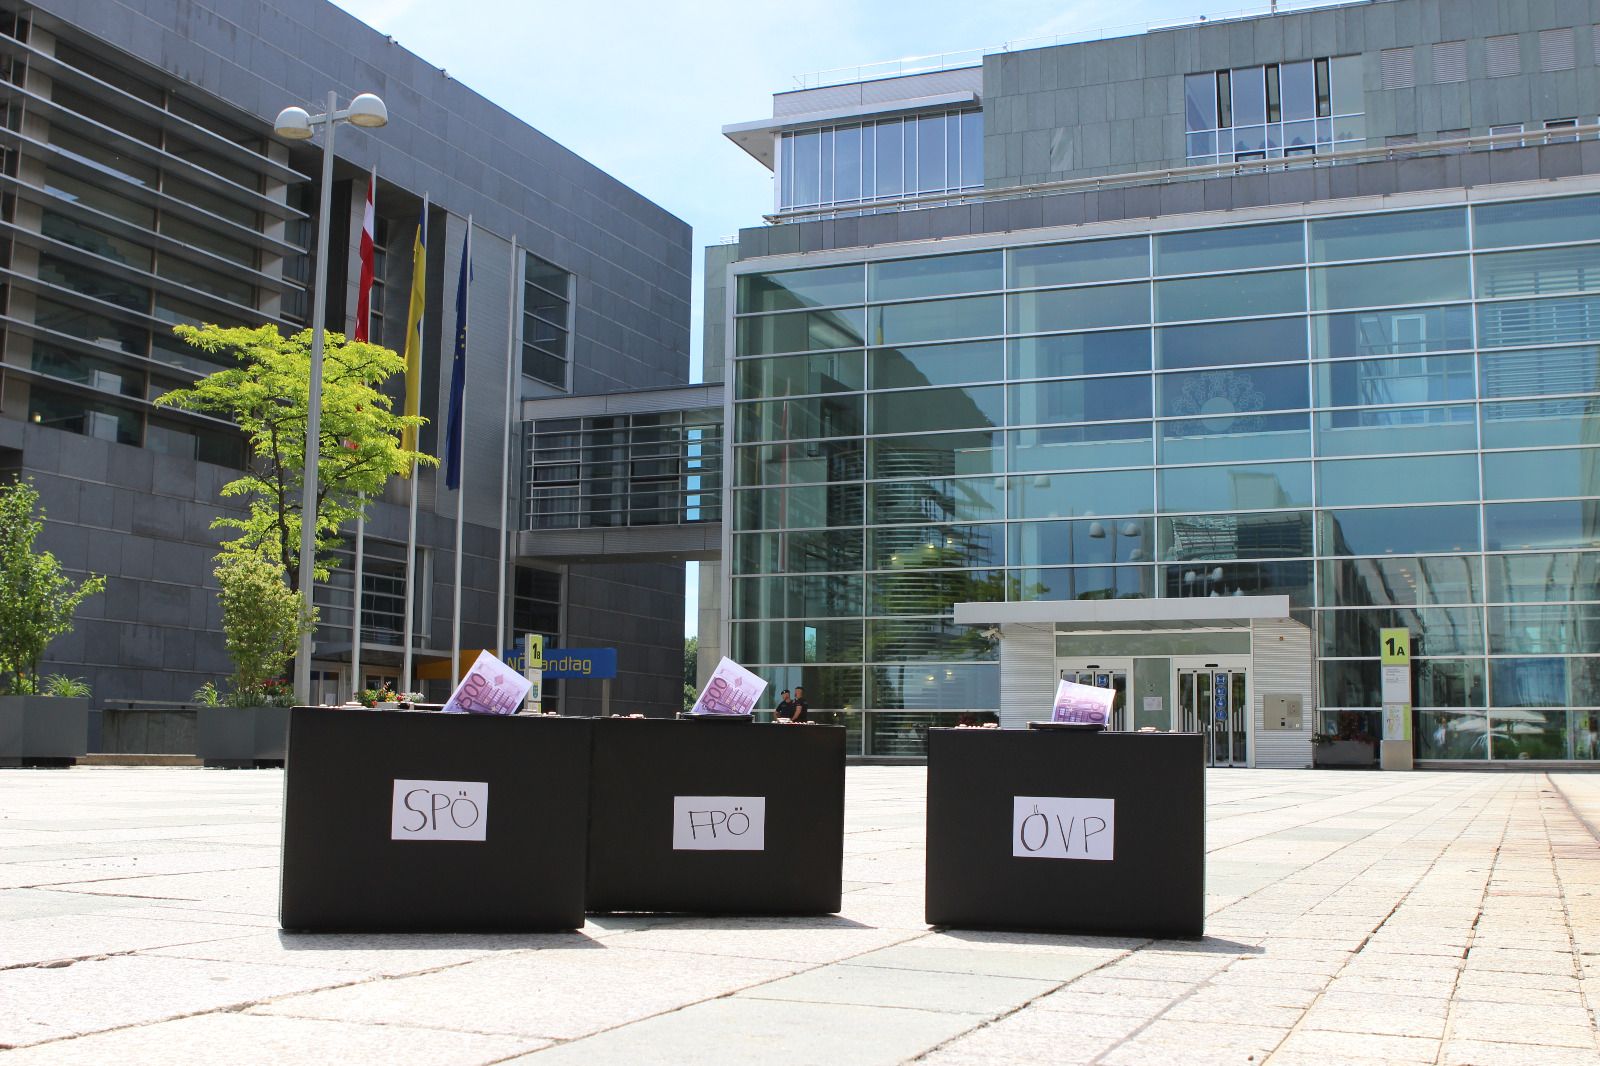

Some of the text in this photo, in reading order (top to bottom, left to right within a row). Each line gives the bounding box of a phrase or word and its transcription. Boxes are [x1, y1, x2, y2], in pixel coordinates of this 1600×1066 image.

[533, 643, 540, 659] 1B
[1385, 638, 1405, 656] 1A
[541, 656, 592, 674] andtag
[456, 673, 487, 710] 500
[702, 677, 727, 712] 500
[403, 789, 479, 832] SPÖ
[688, 806, 750, 840] FPÖ
[1021, 804, 1106, 853] ÖVP
